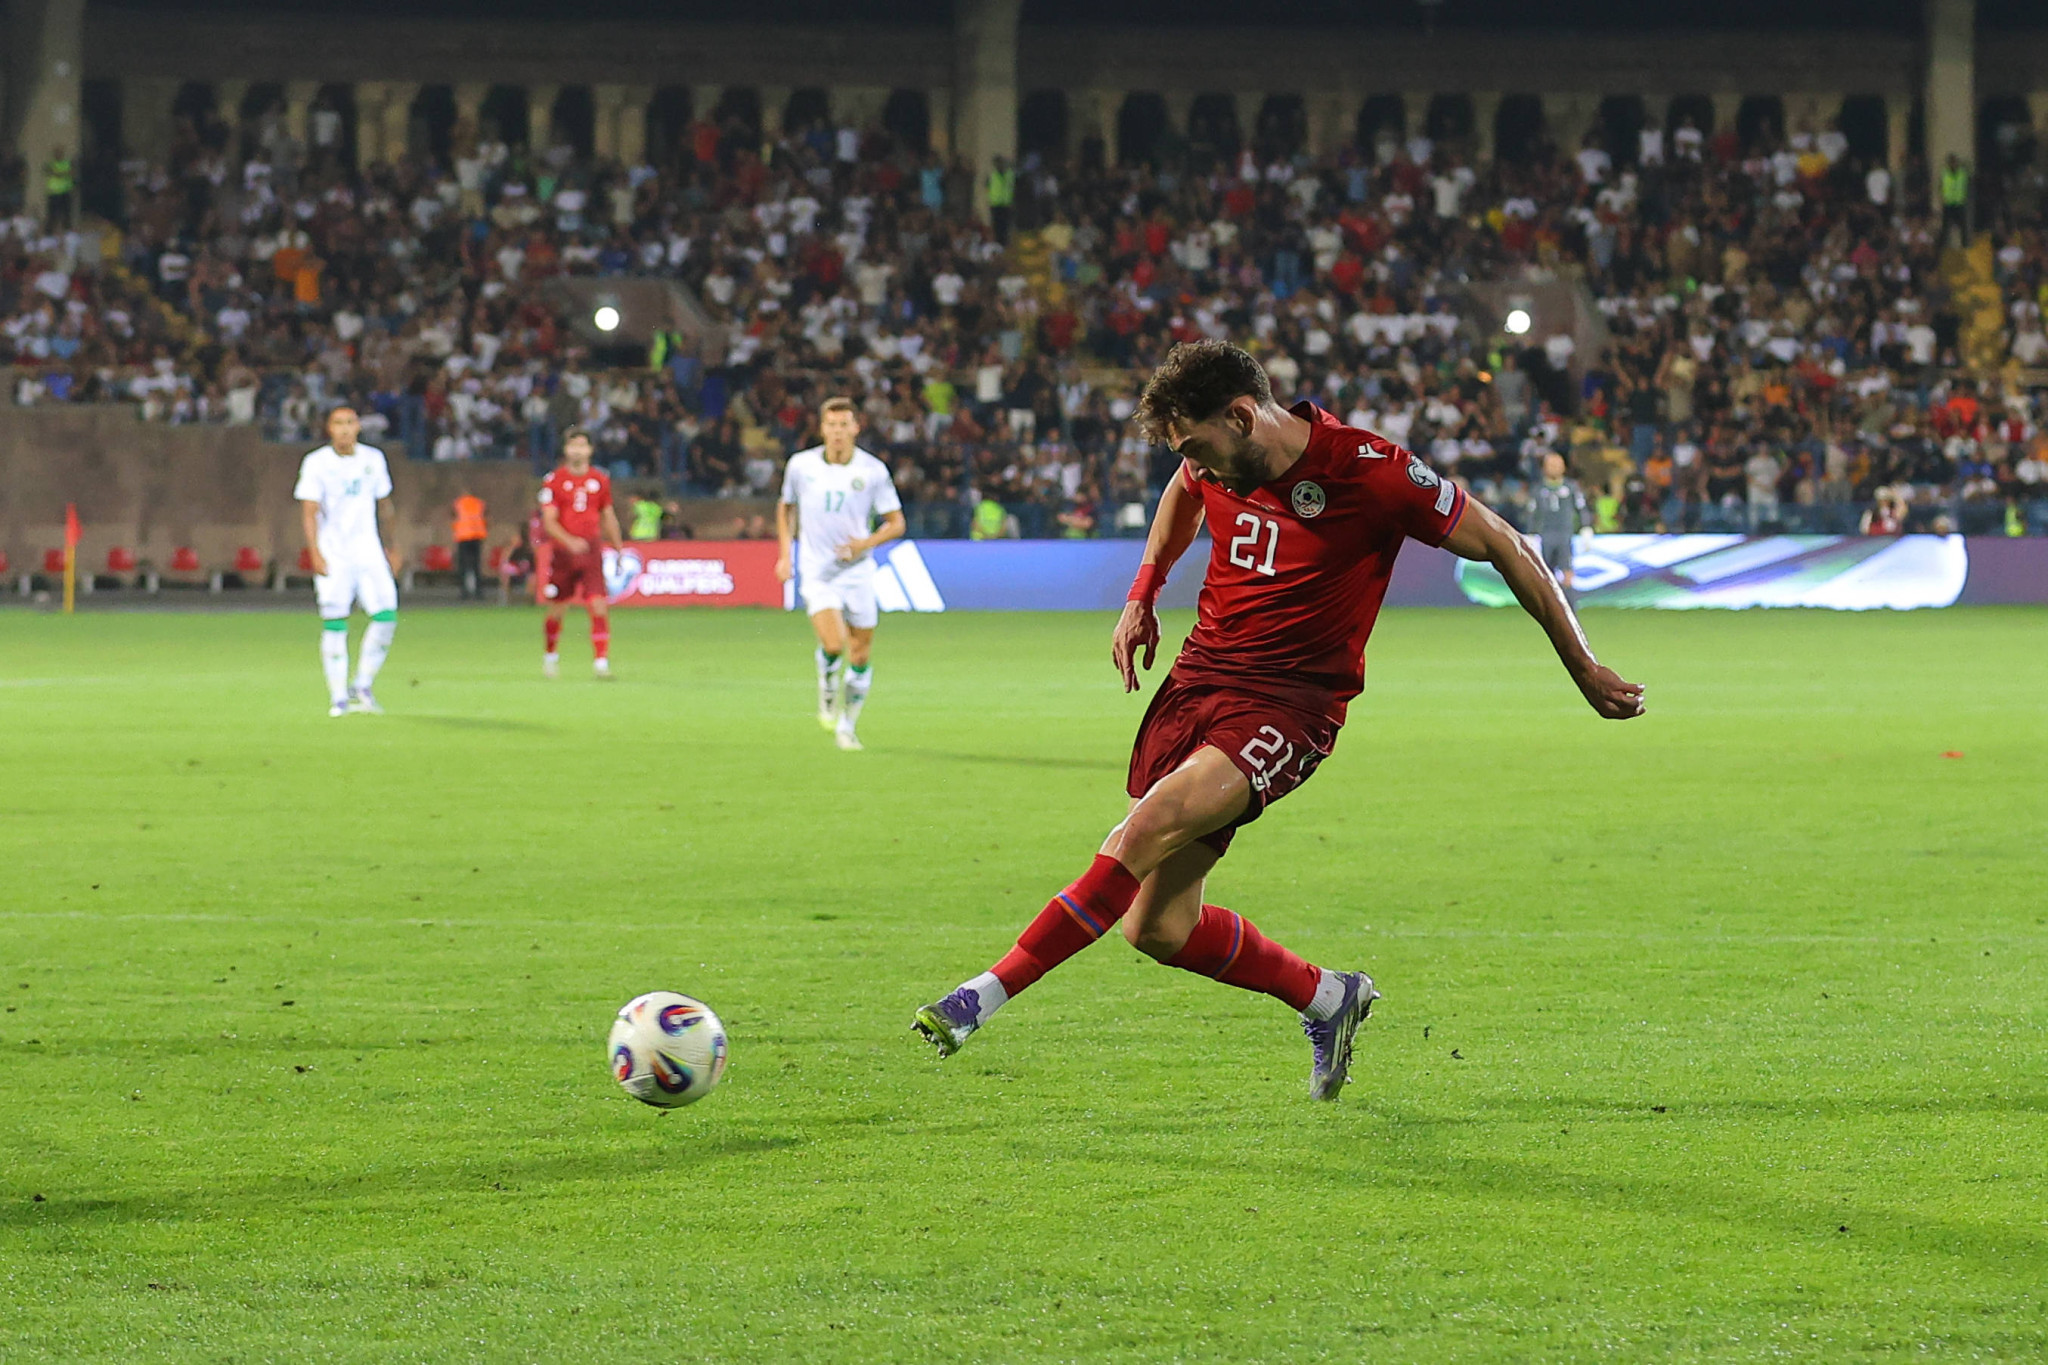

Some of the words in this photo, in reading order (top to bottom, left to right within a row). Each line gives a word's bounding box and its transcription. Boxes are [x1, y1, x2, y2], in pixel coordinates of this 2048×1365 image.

[824, 490, 846, 513] 17
[1230, 512, 1280, 577] 21
[1239, 725, 1294, 789] 21
